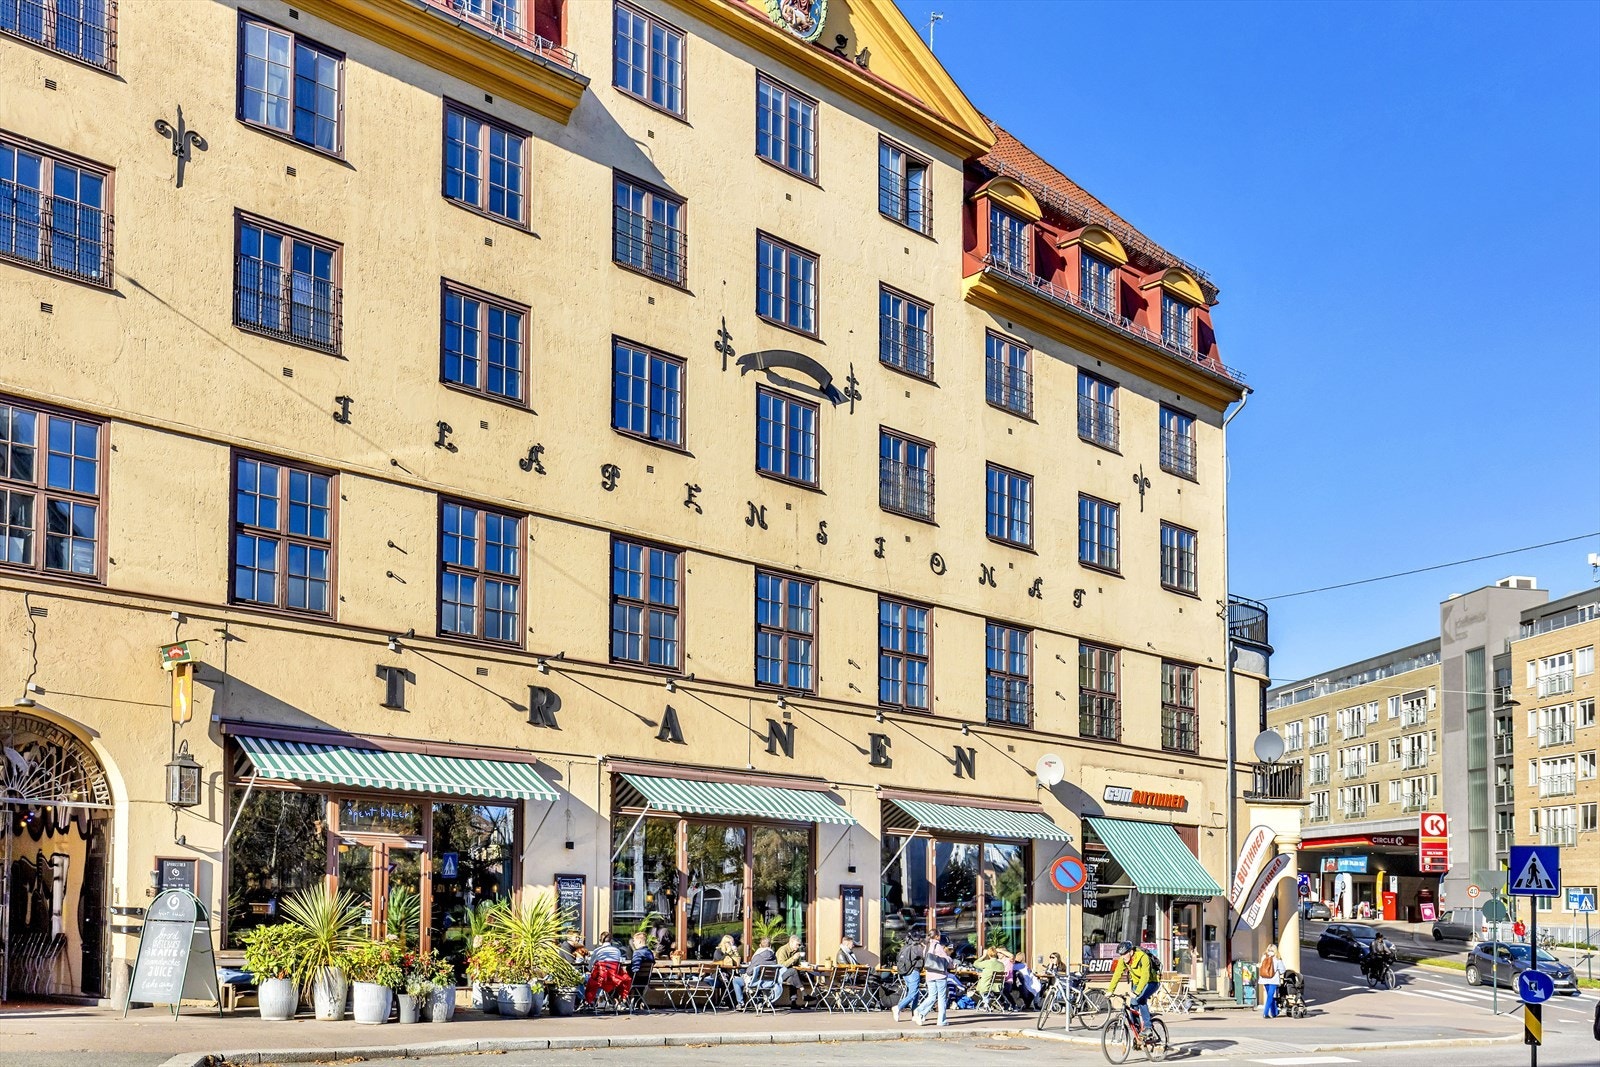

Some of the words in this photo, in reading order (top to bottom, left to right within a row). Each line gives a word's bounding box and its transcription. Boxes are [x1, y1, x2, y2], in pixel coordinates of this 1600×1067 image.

[376, 664, 978, 780] TRANEN
[1428, 817, 1444, 834] K
[1396, 836, 1404, 846] K
[1083, 890, 1098, 899] TRY
[1083, 899, 1098, 908] ING
[1089, 959, 1113, 972] GYM
[147, 966, 173, 977] JUICE
